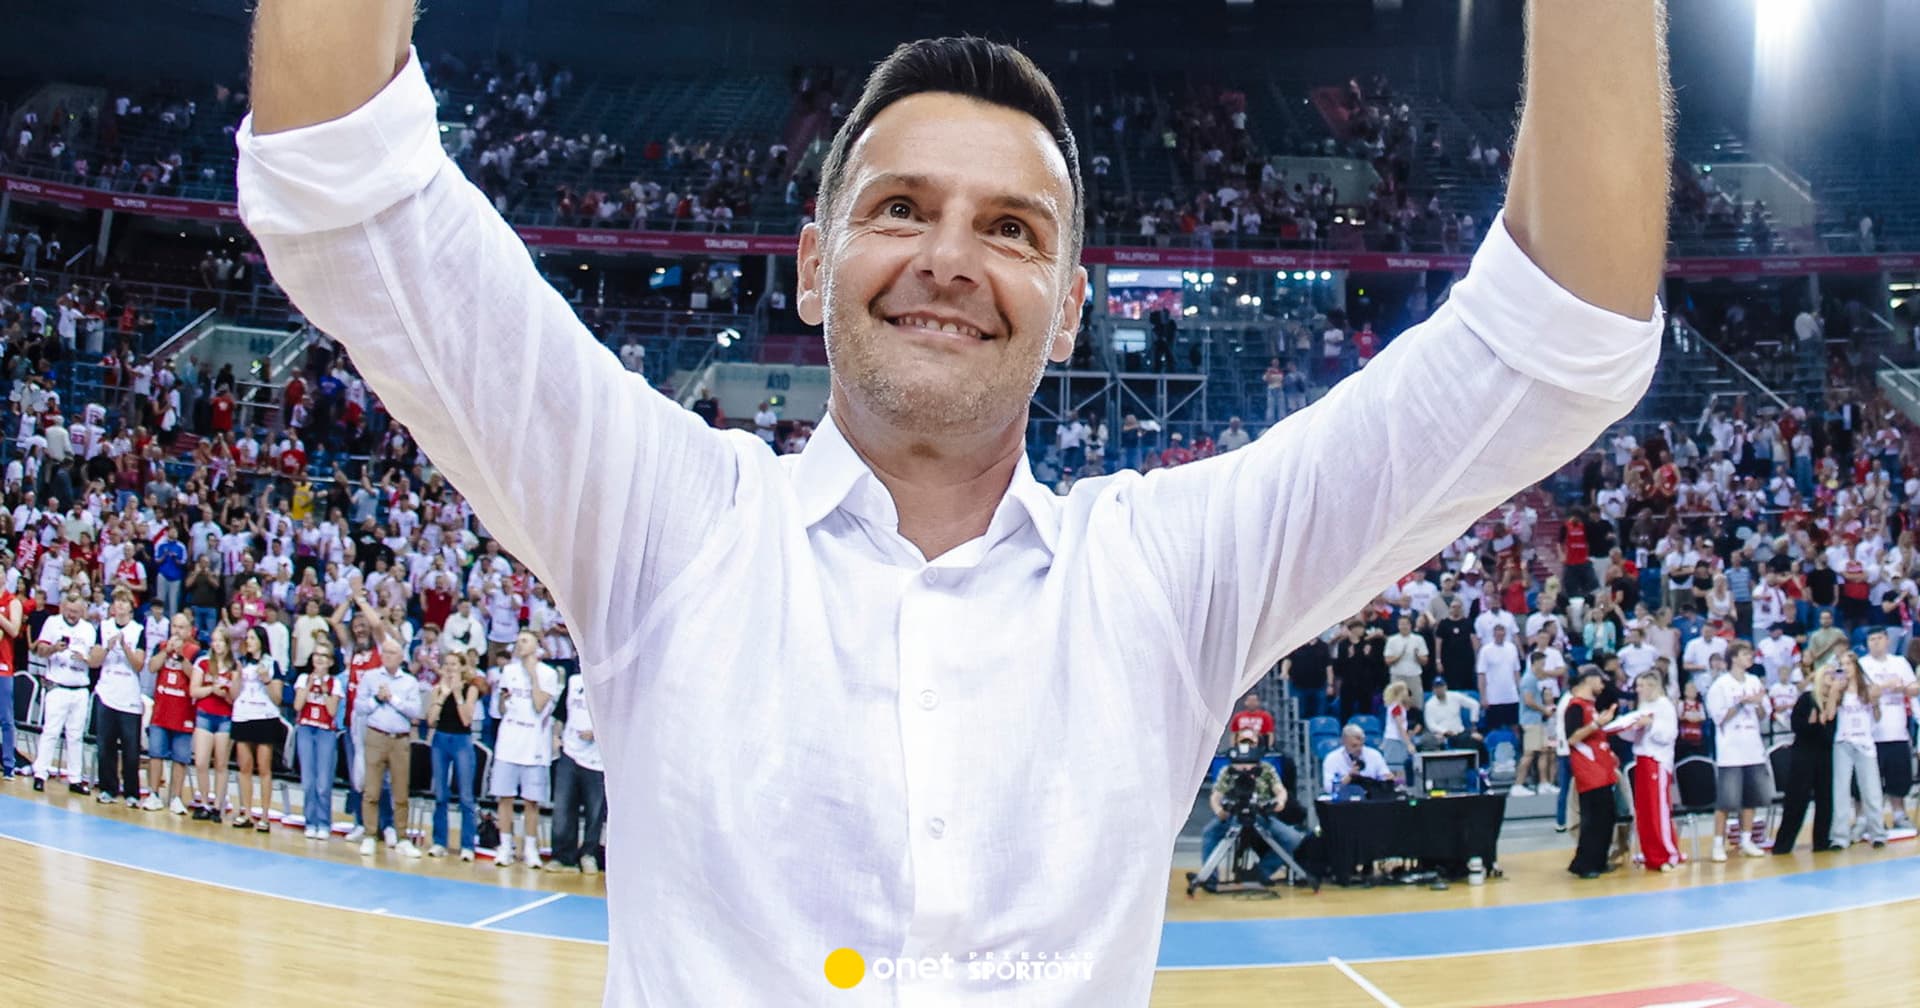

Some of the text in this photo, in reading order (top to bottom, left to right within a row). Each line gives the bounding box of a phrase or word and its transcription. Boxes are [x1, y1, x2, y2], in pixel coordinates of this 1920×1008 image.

[704, 238, 748, 249] TAURON
[1114, 251, 1160, 262] TAURON
[1251, 255, 1296, 265] TAURON
[1386, 257, 1430, 268] TAURON
